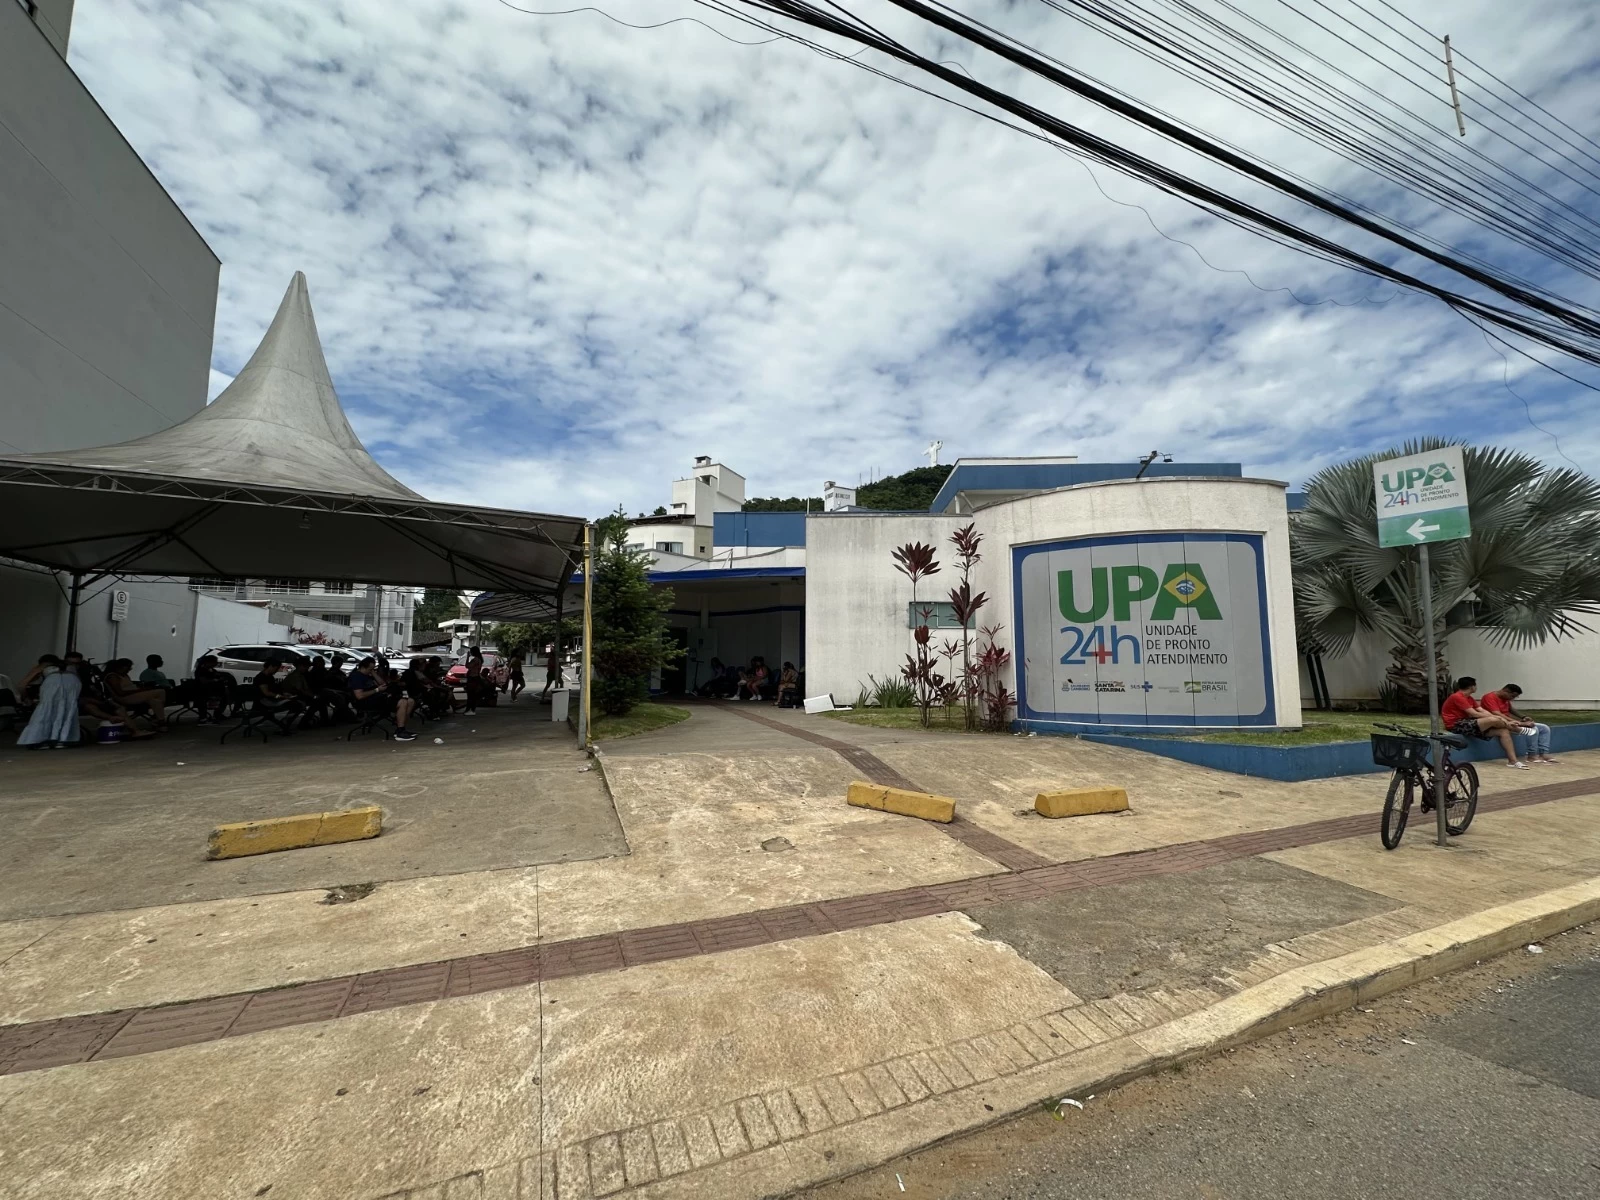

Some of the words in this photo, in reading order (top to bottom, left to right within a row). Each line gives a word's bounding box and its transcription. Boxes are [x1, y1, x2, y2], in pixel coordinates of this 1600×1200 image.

[1382, 462, 1456, 492] UPA
[1420, 485, 1443, 493] UNIDADE
[1384, 490, 1419, 508] 24h
[1421, 493, 1459, 502] ATENDIMENTO
[1057, 563, 1223, 624] UPA
[1145, 624, 1198, 636] UNIDADE
[1060, 625, 1141, 665] 24h
[1146, 639, 1161, 650] DE
[1165, 639, 1211, 650] PRONTO
[1147, 653, 1228, 665] ATENDIMENTO
